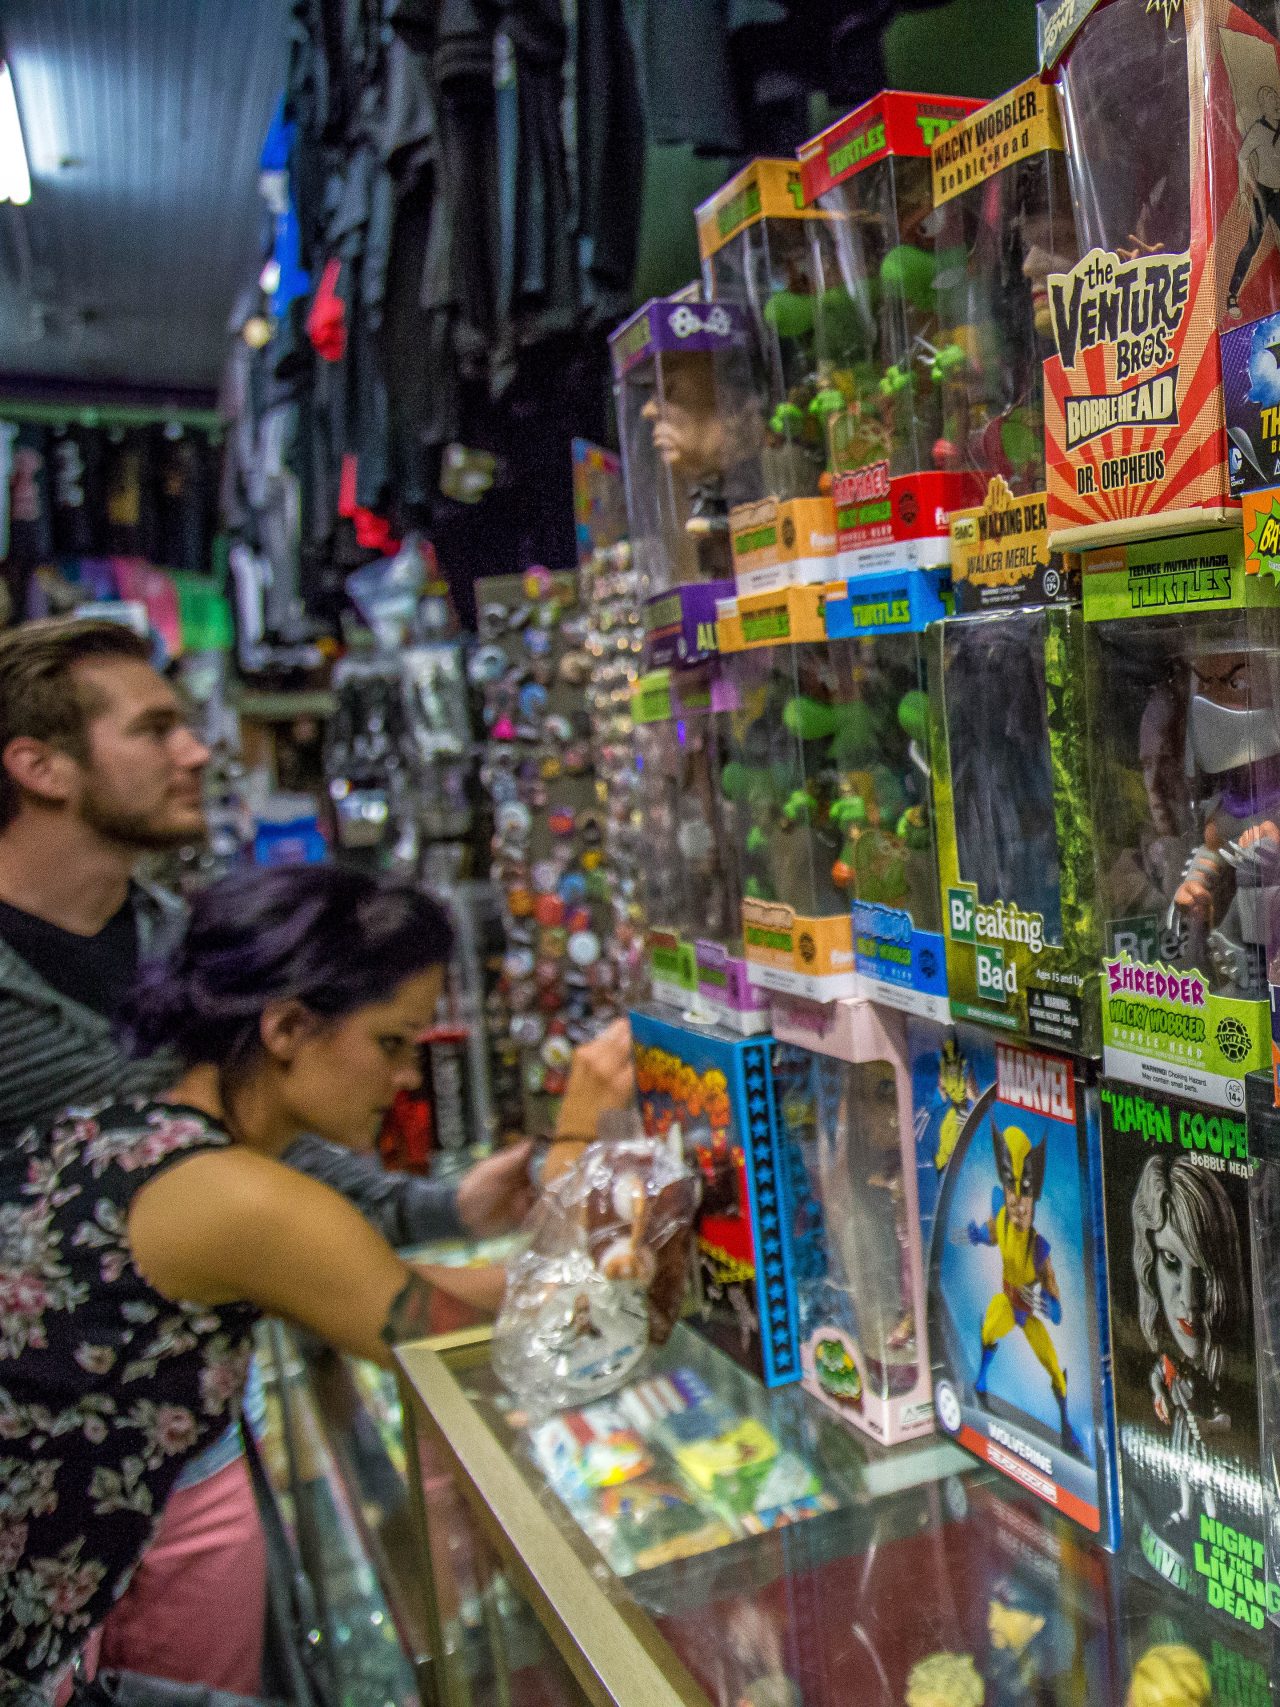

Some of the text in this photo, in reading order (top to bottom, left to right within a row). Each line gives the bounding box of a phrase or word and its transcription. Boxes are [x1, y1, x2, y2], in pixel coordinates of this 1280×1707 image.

[935, 125, 973, 171] WACKY
[976, 91, 1037, 146] WOBBLER
[1084, 258, 1113, 290] the
[1051, 261, 1192, 369] VENTURE
[1066, 376, 1174, 444] BOBBLEHEAD
[1077, 453, 1165, 495] DR. ORPHEUS
[979, 507, 1021, 540] WALKING
[1024, 503, 1047, 531] DEA
[968, 545, 1037, 574] WALKER MERLE
[1129, 563, 1161, 577] TEENAGE
[1163, 558, 1198, 573] MUTANT
[1200, 554, 1228, 568] NINJA
[1128, 567, 1232, 609] TURTLES
[852, 600, 911, 628] TURTLES
[951, 898, 1043, 953] Breaking
[977, 955, 1018, 993] Bad
[1036, 969, 1051, 981] Ages
[1060, 973, 1073, 984] and
[1109, 962, 1205, 1006] SHREDDER
[1109, 999, 1149, 1030] WACKY
[1149, 1007, 1206, 1043] WOBBLER
[1216, 1034, 1252, 1050] TURTLES
[998, 1047, 1073, 1120] MARVEL
[1168, 1070, 1187, 1082] Choking
[1171, 1080, 1183, 1089] small
[1228, 1084, 1240, 1093] AGE
[1229, 1092, 1241, 1103] 14+
[1179, 1111, 1248, 1159] COOPE
[1229, 1161, 1253, 1179] HEAD
[1200, 1513, 1264, 1569] NIGHT
[1212, 1546, 1253, 1579] OF THE
[1208, 1578, 1264, 1630] DEAD
